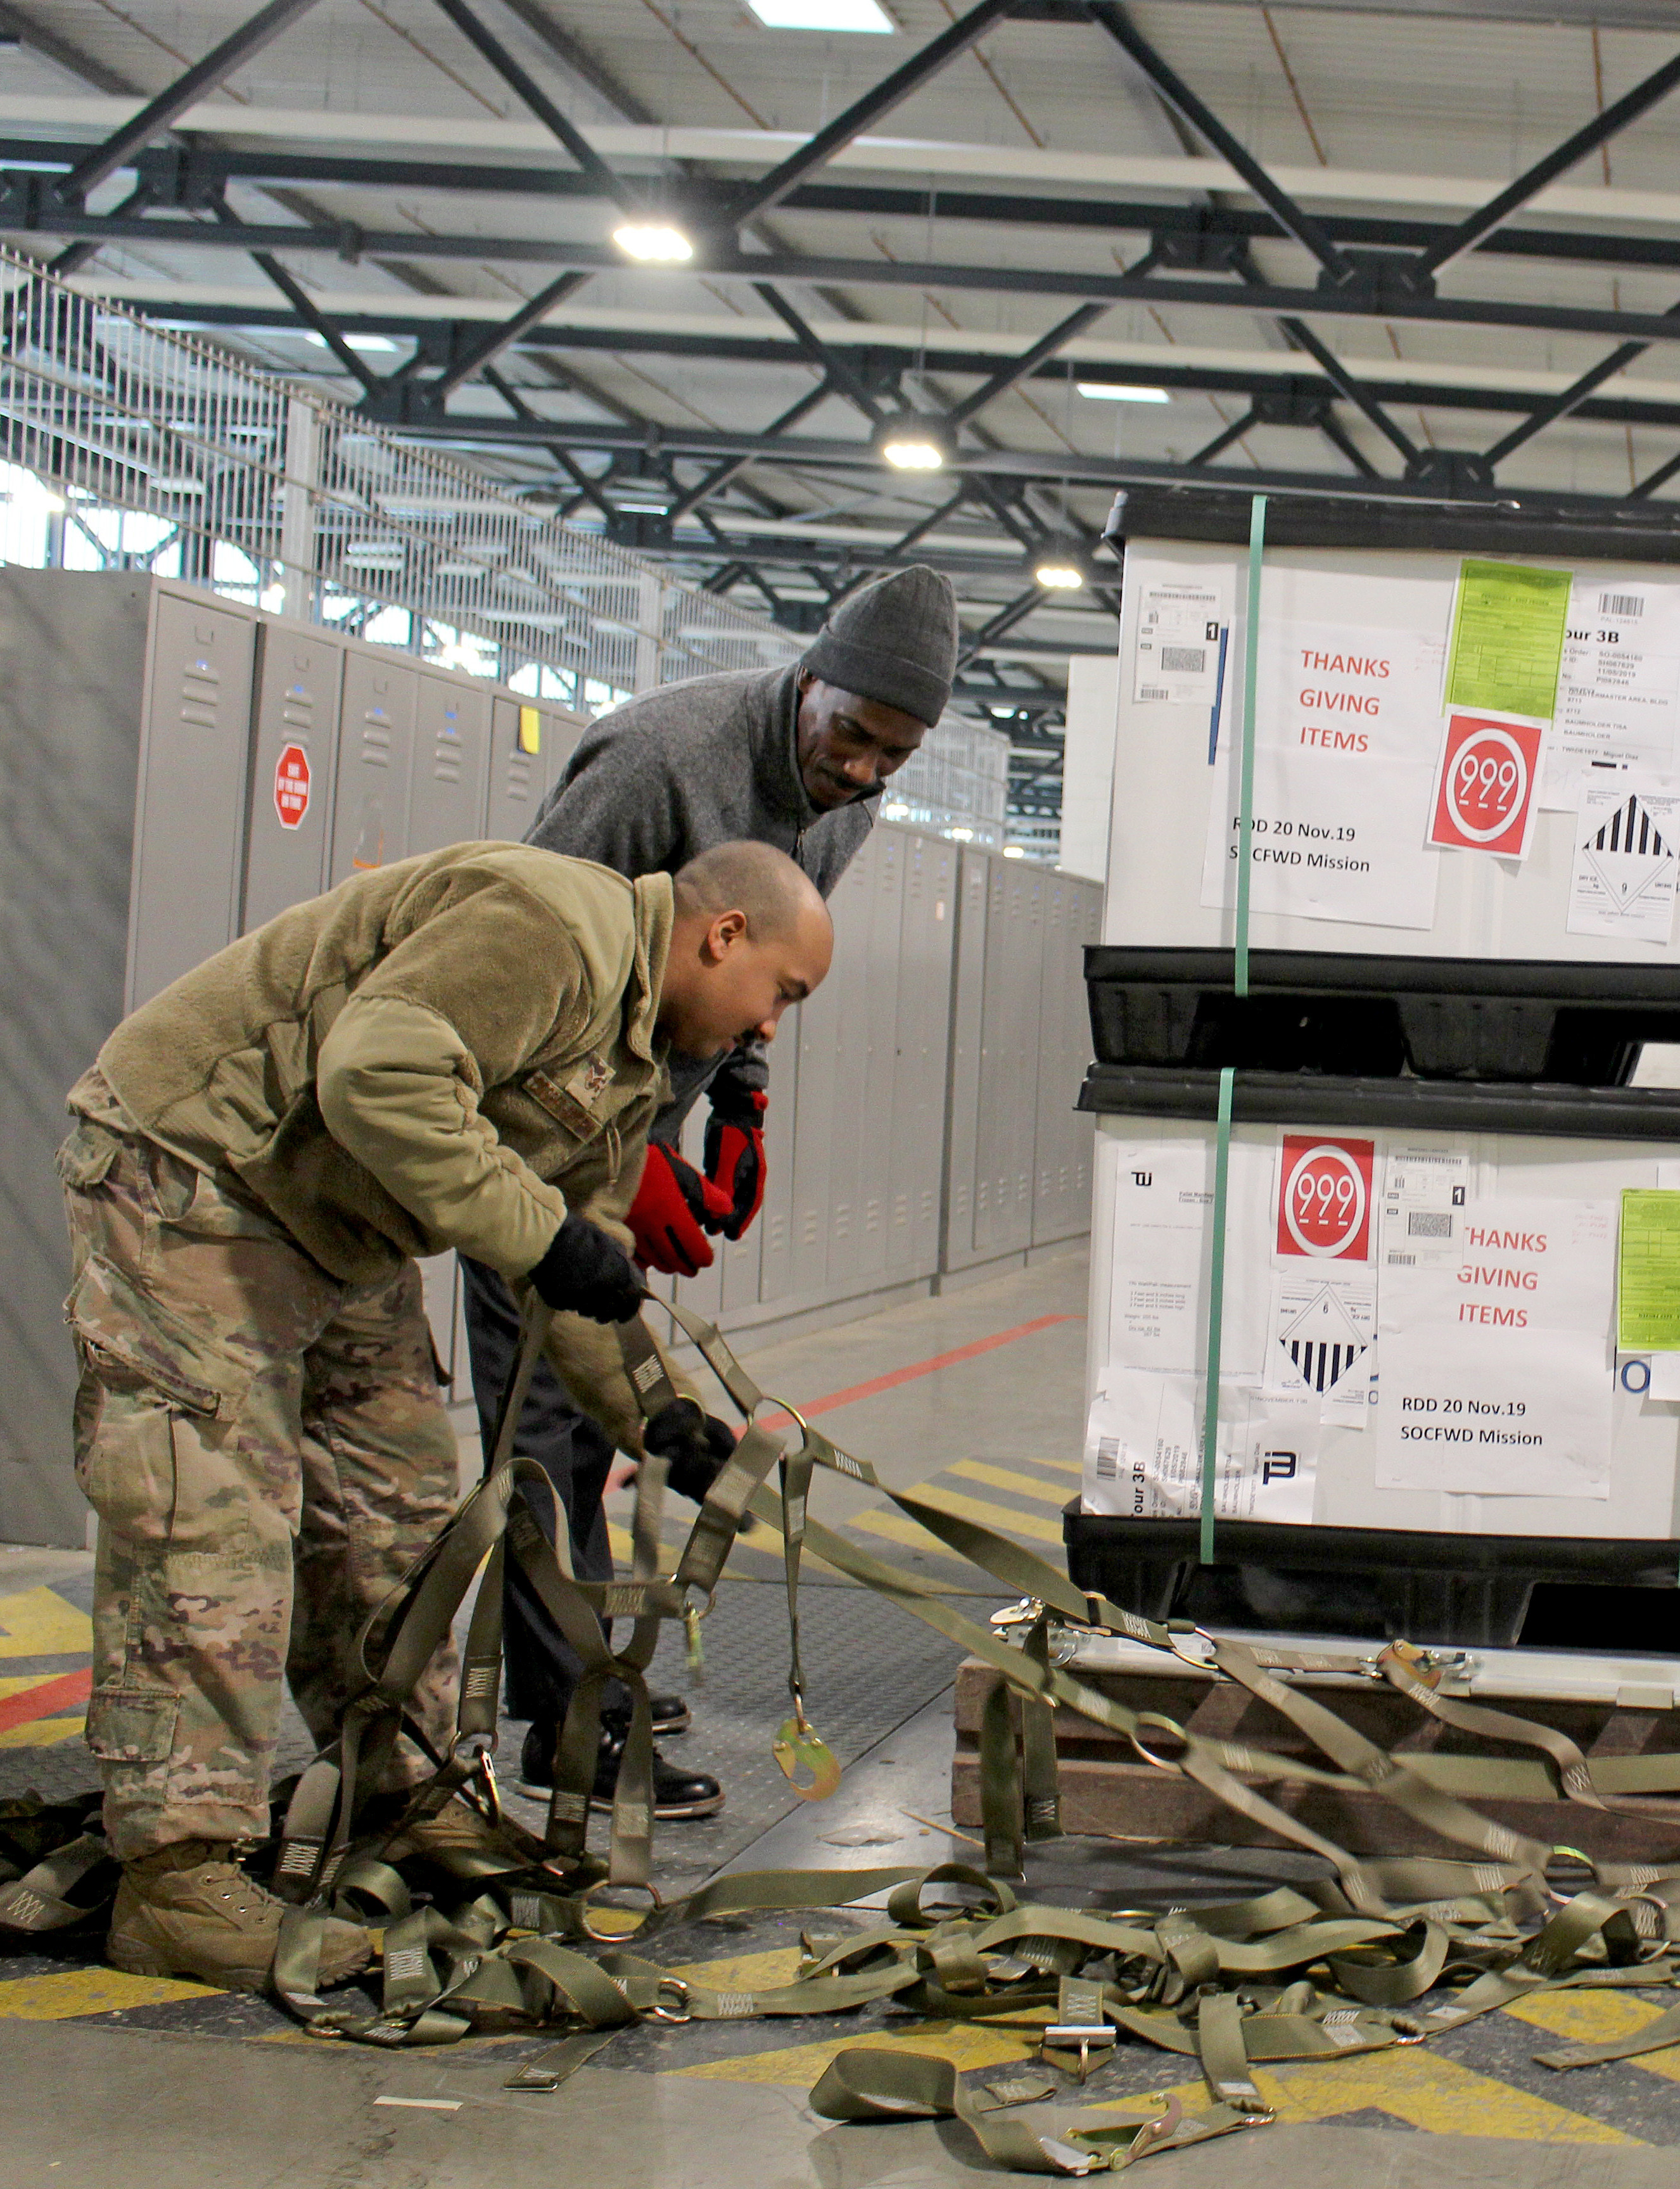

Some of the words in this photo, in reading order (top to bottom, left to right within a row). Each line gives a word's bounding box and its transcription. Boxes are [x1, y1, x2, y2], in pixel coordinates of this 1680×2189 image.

[1207, 623, 1216, 640] 1
[1596, 630, 1619, 644] 3B
[1301, 649, 1390, 678] THANKS
[1299, 688, 1380, 715] GIVING
[1301, 726, 1369, 752] ITEMS
[1460, 754, 1517, 804] 999
[1232, 816, 1268, 832] RD
[1273, 821, 1293, 835] 20
[1298, 823, 1356, 842] Nov.19
[1229, 845, 1302, 865] SCFWD
[1306, 853, 1370, 872] Mission
[1297, 1172, 1355, 1219] 999
[1454, 1188, 1463, 1204] 1
[1465, 1227, 1547, 1253] HANKS
[1457, 1265, 1538, 1290] GIVING
[1459, 1303, 1528, 1328] ITEMS
[1402, 1397, 1437, 1412] RDD
[1443, 1399, 1462, 1413] 20
[1468, 1400, 1526, 1416] Nov.19
[1401, 1426, 1473, 1443] SOCFWD
[1479, 1429, 1543, 1445] Mission
[1132, 1461, 1146, 1483] 3B
[1132, 1488, 1144, 1515] our
